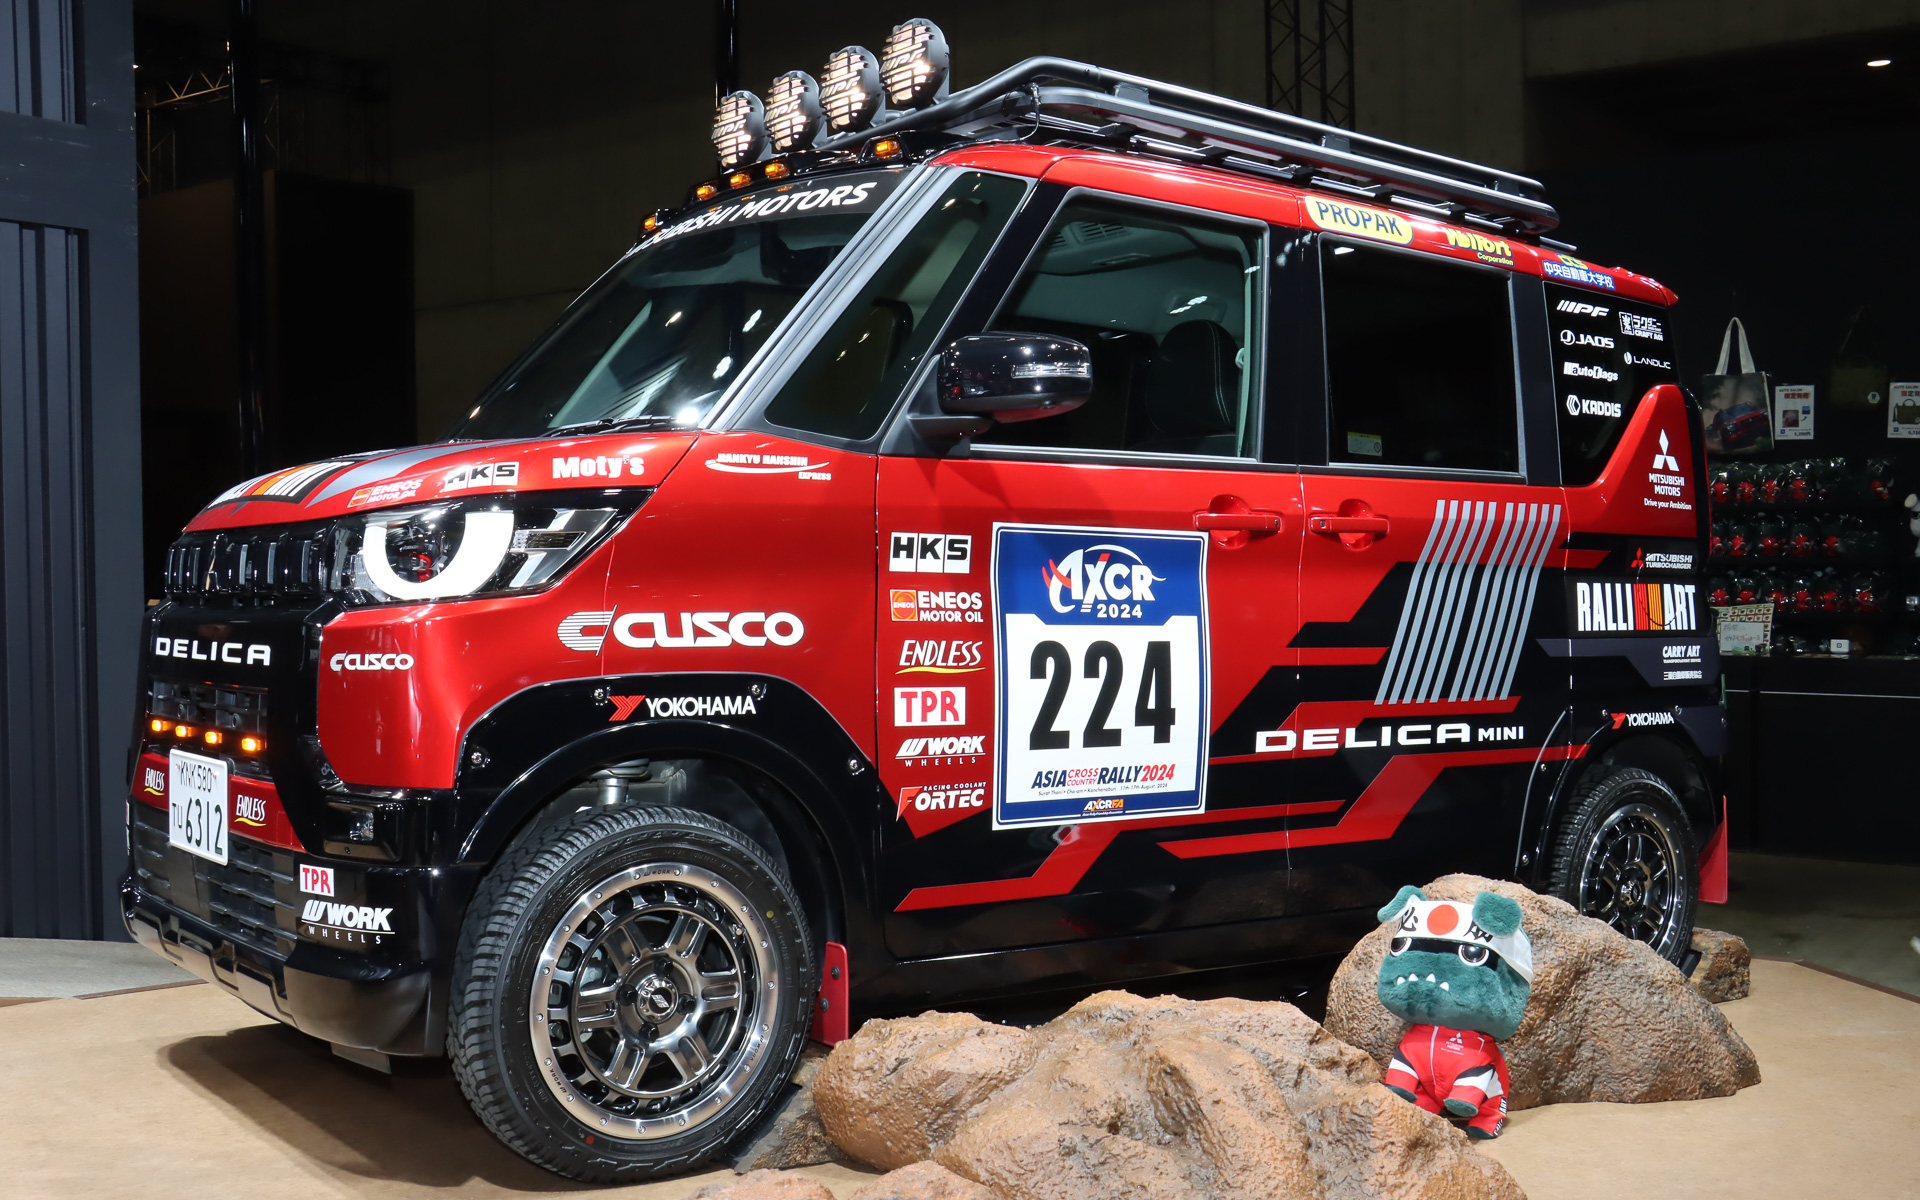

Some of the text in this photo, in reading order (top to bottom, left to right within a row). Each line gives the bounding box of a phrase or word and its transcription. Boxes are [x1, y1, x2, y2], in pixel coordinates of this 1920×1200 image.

[729, 181, 877, 222] MOTORS
[1316, 200, 1403, 237] PROPAK
[1477, 253, 1514, 266] Corporation
[1544, 261, 1615, 290] 中央自動車大学校
[1575, 334, 1615, 349] JAOS
[1582, 399, 1622, 418] KADDIS
[552, 454, 645, 479] Moty's
[762, 454, 809, 466] HANSHIN
[447, 464, 517, 484] HKS
[798, 471, 832, 481] EXPRESS
[1648, 472, 1685, 486] MITSUBISHI
[366, 492, 401, 504] MOTOR
[401, 490, 417, 498] OIL
[371, 479, 423, 496] ENEOS
[1654, 485, 1681, 497] MOTORS
[1644, 498, 1692, 510] Drive your Ambition
[892, 536, 969, 561] HKS
[917, 590, 983, 610] ENEOS
[919, 610, 984, 623] MOTOR OIL
[1096, 604, 1143, 619] 2024
[155, 637, 272, 666] DELICA
[899, 639, 983, 667] ENDLESS
[1662, 645, 1701, 658] CARRY ART
[1029, 640, 1176, 751] 224
[645, 695, 757, 718] YOKOHAMA
[900, 690, 960, 723] TPR
[1626, 711, 1675, 727] YOKOHAMA
[927, 735, 986, 756] WORK
[1255, 722, 1524, 753] DELICA MINI
[904, 756, 976, 767] WHEELS
[144, 766, 165, 791] ENDLESS
[923, 781, 987, 792] RACING COOLANT
[1031, 763, 1176, 790] ASIA CROSS RALLY 2024
[1066, 777, 1097, 787] COUNTRY
[235, 794, 267, 822] ENDLESS
[185, 796, 223, 856] 6312
[302, 867, 331, 894] TPR
[326, 904, 394, 931] WORK
[308, 925, 382, 945] WHEELS
